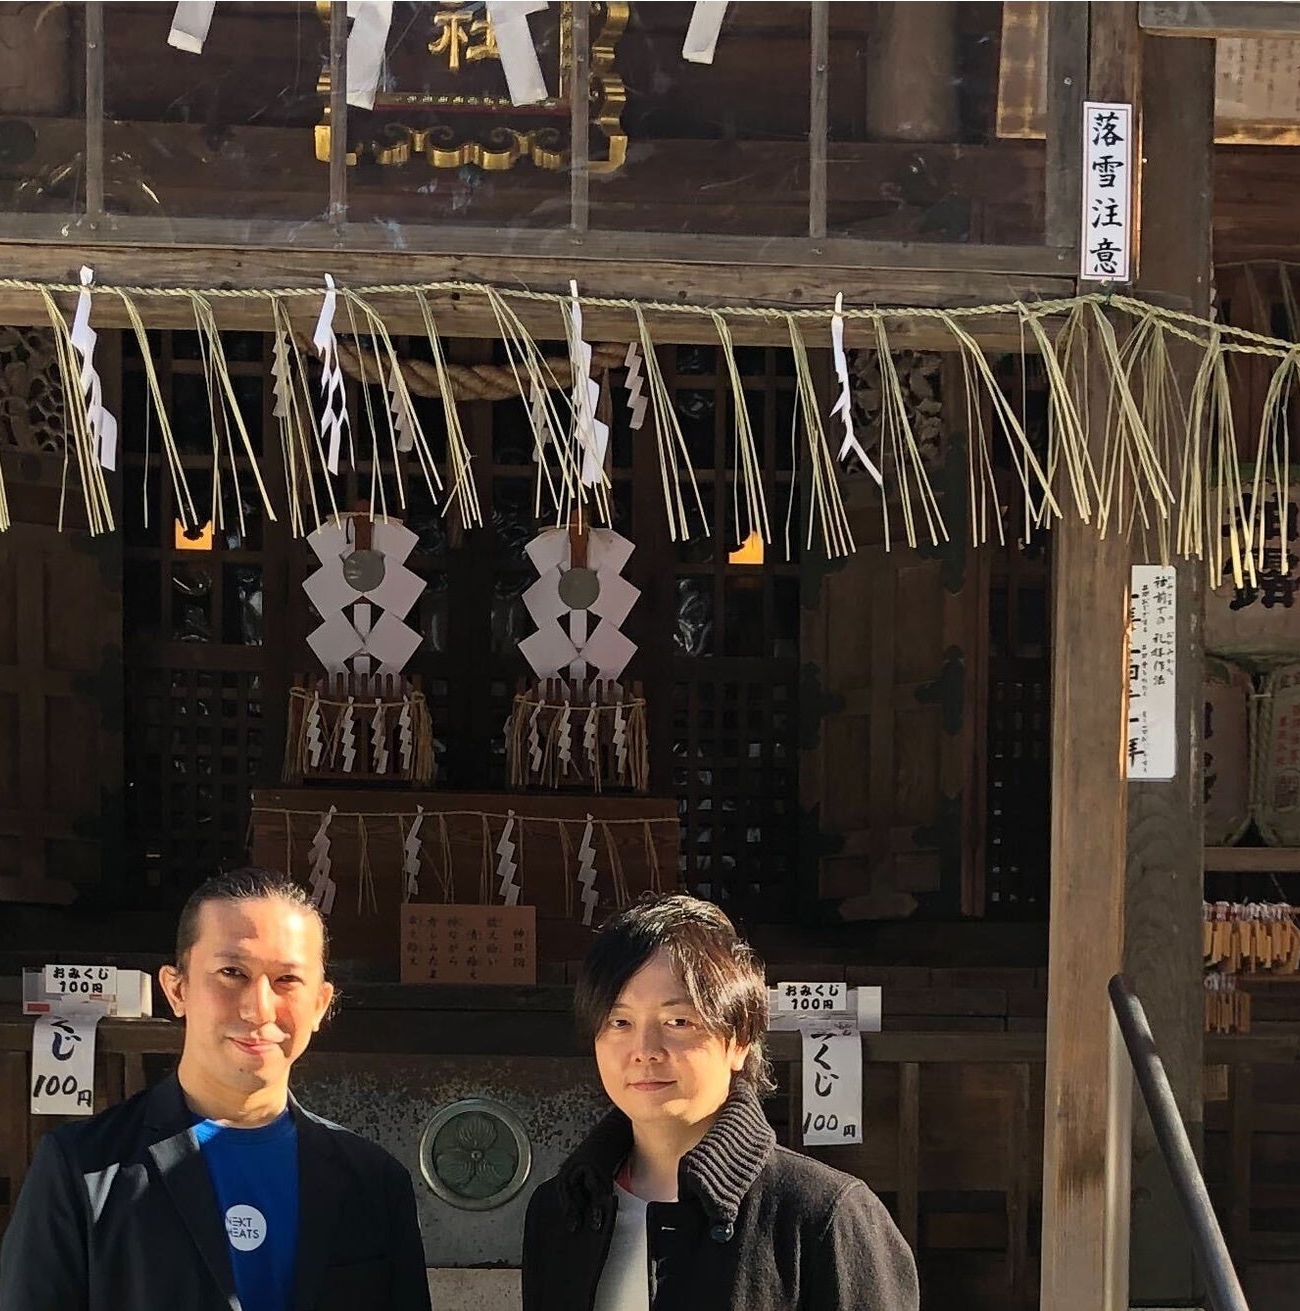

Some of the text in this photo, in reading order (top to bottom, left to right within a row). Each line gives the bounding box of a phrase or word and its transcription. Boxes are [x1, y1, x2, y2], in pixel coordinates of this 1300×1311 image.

[1089, 111, 1125, 274] 落雪注意
[53, 967, 109, 980] おみくじ
[60, 981, 103, 993] 100円
[785, 984, 839, 997] おみくじ
[791, 999, 834, 1010] 100円
[33, 1075, 92, 1107] 100円
[803, 1112, 856, 1138] 100円
